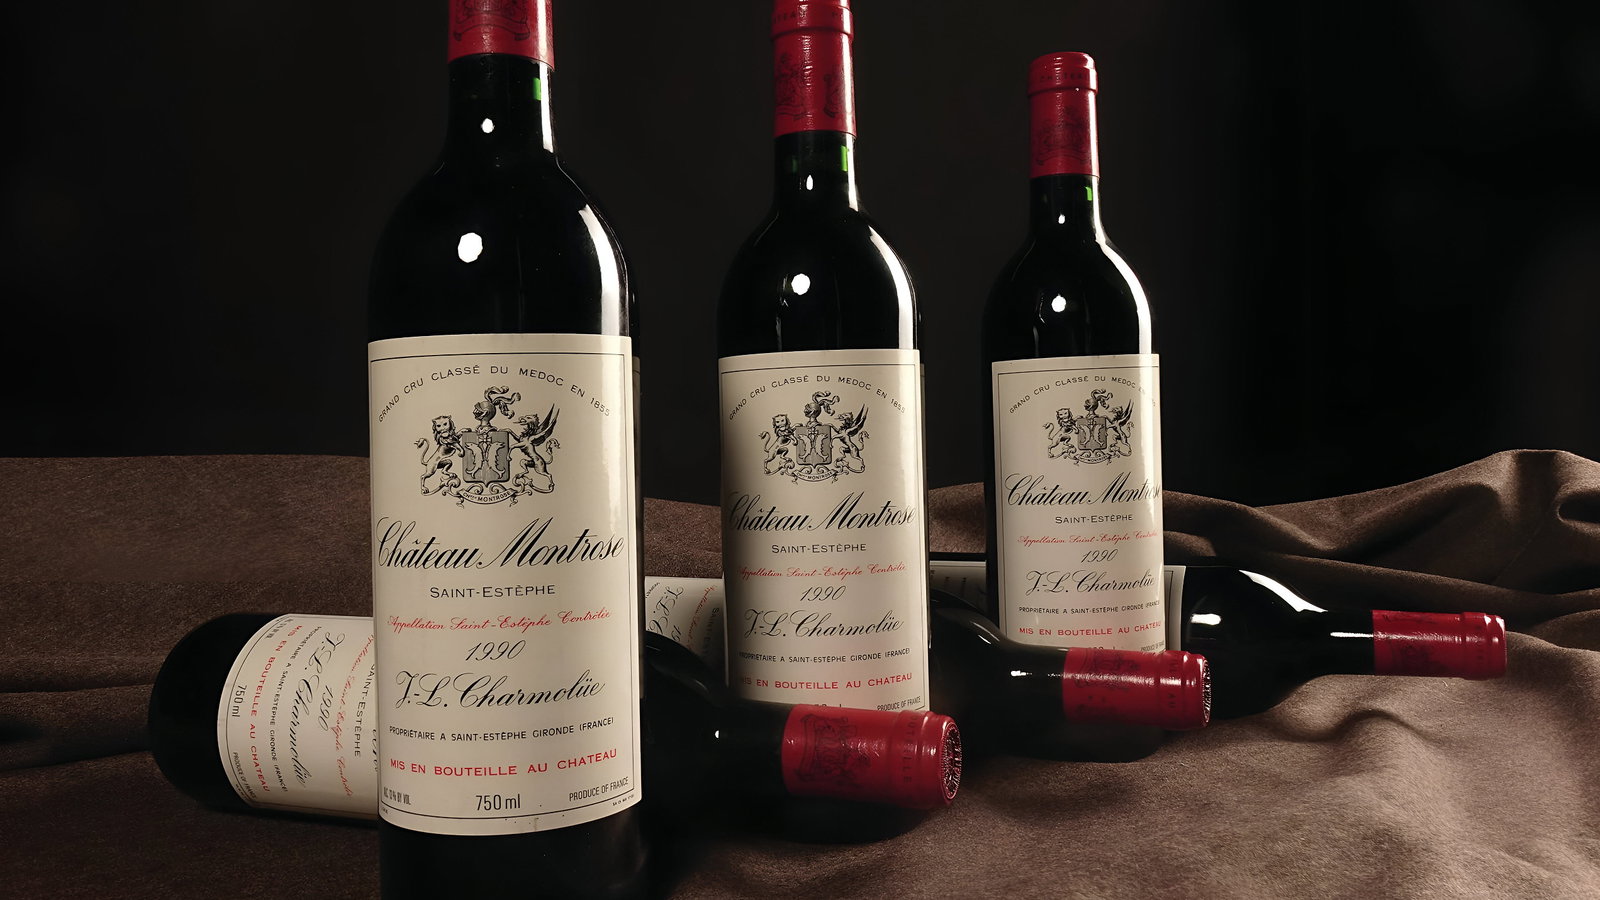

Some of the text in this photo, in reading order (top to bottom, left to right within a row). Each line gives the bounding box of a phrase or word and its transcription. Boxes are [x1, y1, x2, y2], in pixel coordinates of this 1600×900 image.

[378, 365, 611, 423] GRAND CRU CLASSÉ DU MEDOC EN 1855
[729, 398, 747, 420] GRAND
[750, 386, 766, 399] CRU
[771, 375, 809, 388] CLASSÉ
[816, 375, 831, 383] DU
[838, 376, 872, 391] MEDOC
[876, 388, 888, 399] EN
[1009, 395, 1031, 414] GRAND
[1033, 384, 1050, 396] CRU
[1055, 375, 1089, 387] CLASSÉ
[1111, 376, 1136, 389] MEDOC
[1004, 472, 1091, 506] Château
[728, 490, 916, 531] Château Montrose
[376, 515, 625, 569] Château Montrose
[1080, 548, 1118, 563] 1990
[799, 585, 847, 602] 1990
[387, 614, 446, 635] Appellation
[1019, 627, 1034, 635] MIS
[1039, 628, 1051, 636] EN
[1057, 628, 1113, 636] BOUTEILLE
[1118, 626, 1130, 634] AU
[275, 640, 288, 652] EN
[465, 639, 527, 662] 1990
[850, 652, 882, 662] GIRONDE
[250, 657, 276, 717] BOUTEILLE
[452, 669, 606, 708] Charmolüe
[756, 679, 769, 688] EN
[775, 680, 839, 690] BOUTEILLE
[845, 679, 862, 689] AU
[867, 673, 913, 687] CHATEAU
[231, 684, 248, 718] 750 ml
[318, 685, 335, 731] 1990
[249, 723, 256, 739] AU
[269, 730, 278, 761] GIRONDE
[439, 733, 447, 741] A
[532, 724, 575, 739] GIRONDE
[250, 745, 270, 792] CHATEAU
[390, 748, 618, 777] MIS EN BOUTEILLE AU CHATEAU
[475, 793, 521, 811] 750 ml
[569, 786, 600, 801] PRODUCE
[601, 784, 609, 794] OF
[610, 776, 629, 790] FRANCE
